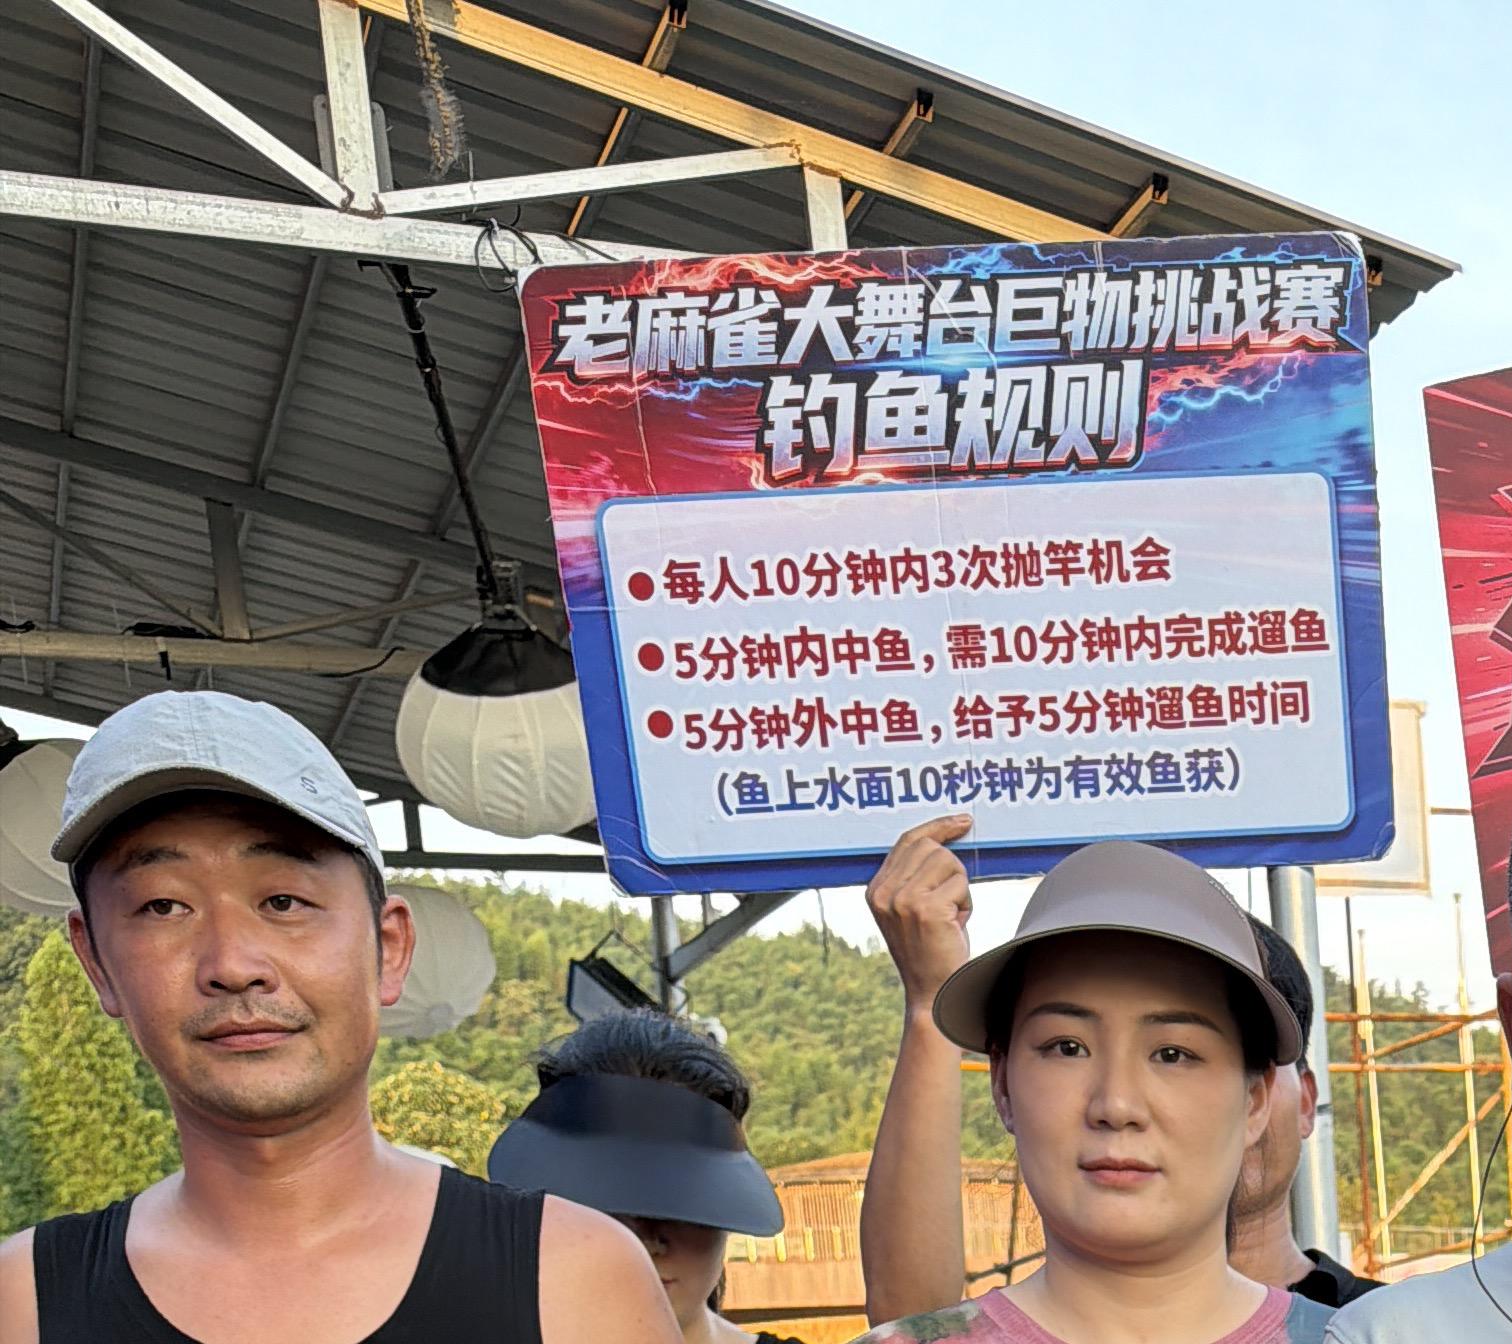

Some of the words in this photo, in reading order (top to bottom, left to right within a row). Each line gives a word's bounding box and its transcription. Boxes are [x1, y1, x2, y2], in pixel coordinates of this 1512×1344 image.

[557, 267, 1344, 376] 老麻雀大舞台巨物挑战赛
[765, 361, 1141, 474] 钓鱼规则
[663, 538, 1172, 605] 每人10分钟内3次抛竿机会
